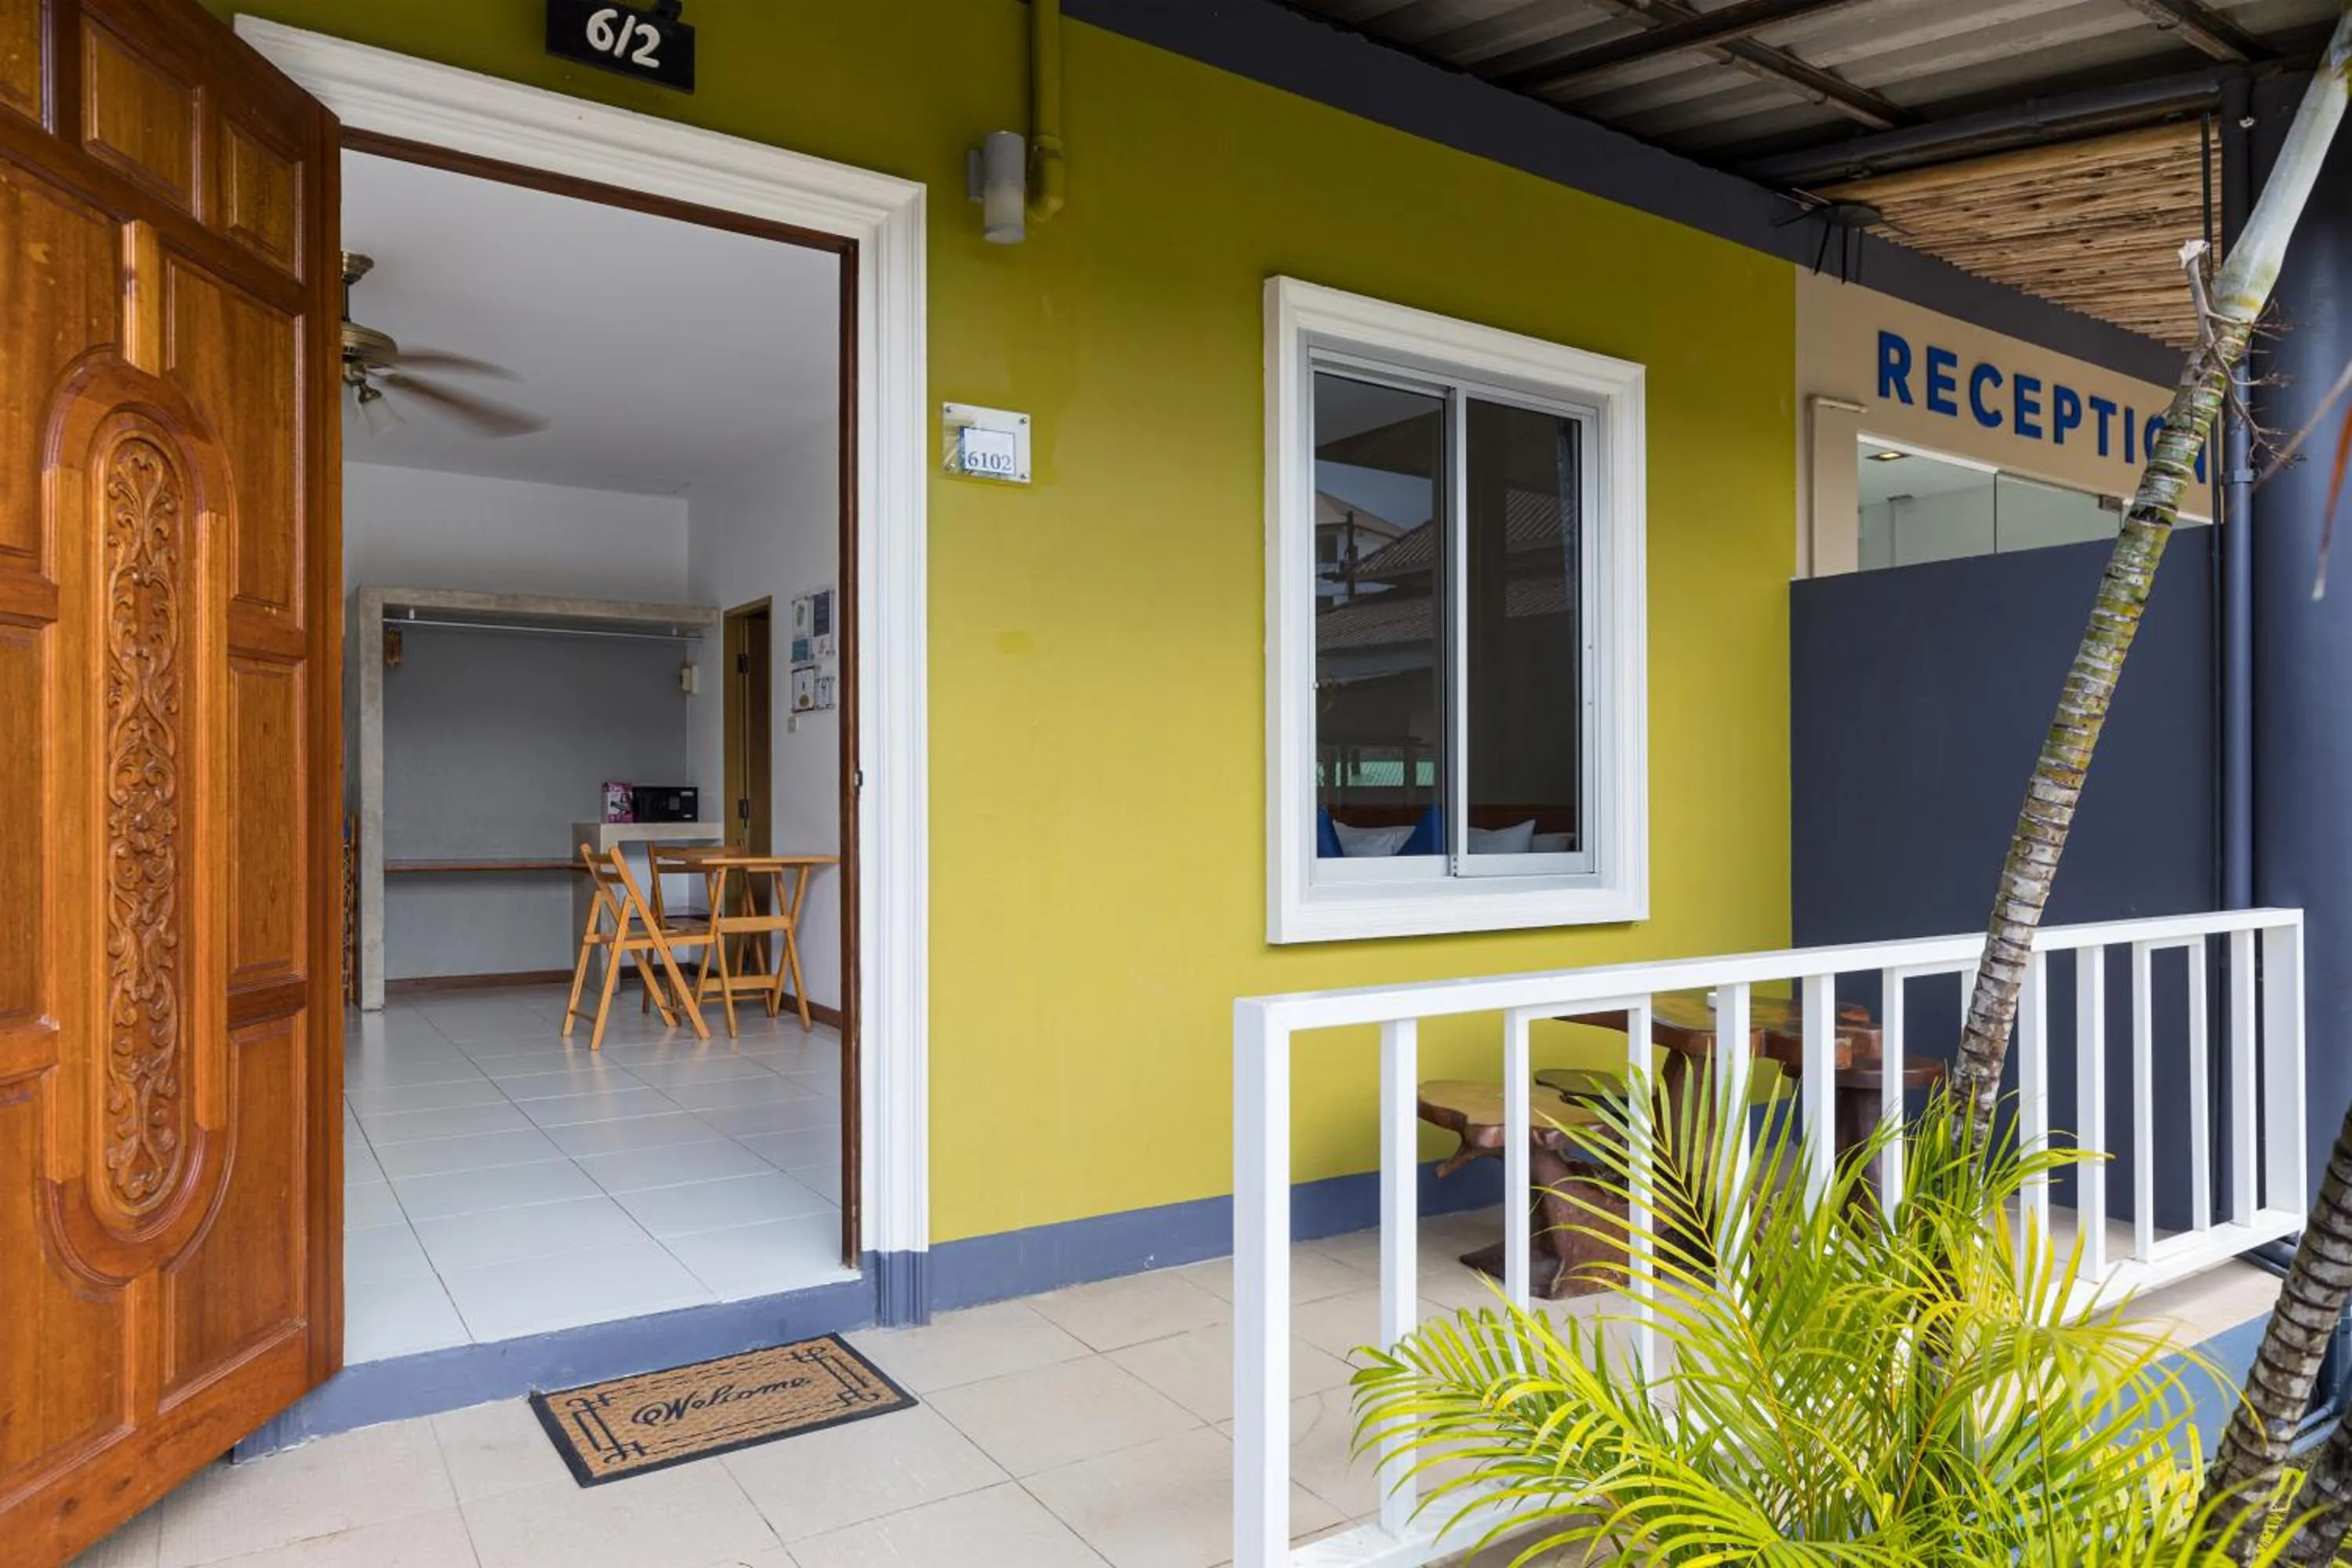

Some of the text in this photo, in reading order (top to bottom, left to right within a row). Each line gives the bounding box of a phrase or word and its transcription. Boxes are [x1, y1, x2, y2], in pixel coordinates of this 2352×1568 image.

[586, 9, 660, 68] 6/2
[1878, 330, 2206, 485] RECEPTI
[967, 451, 1012, 470] 6102
[631, 1377, 811, 1426] Welcome
